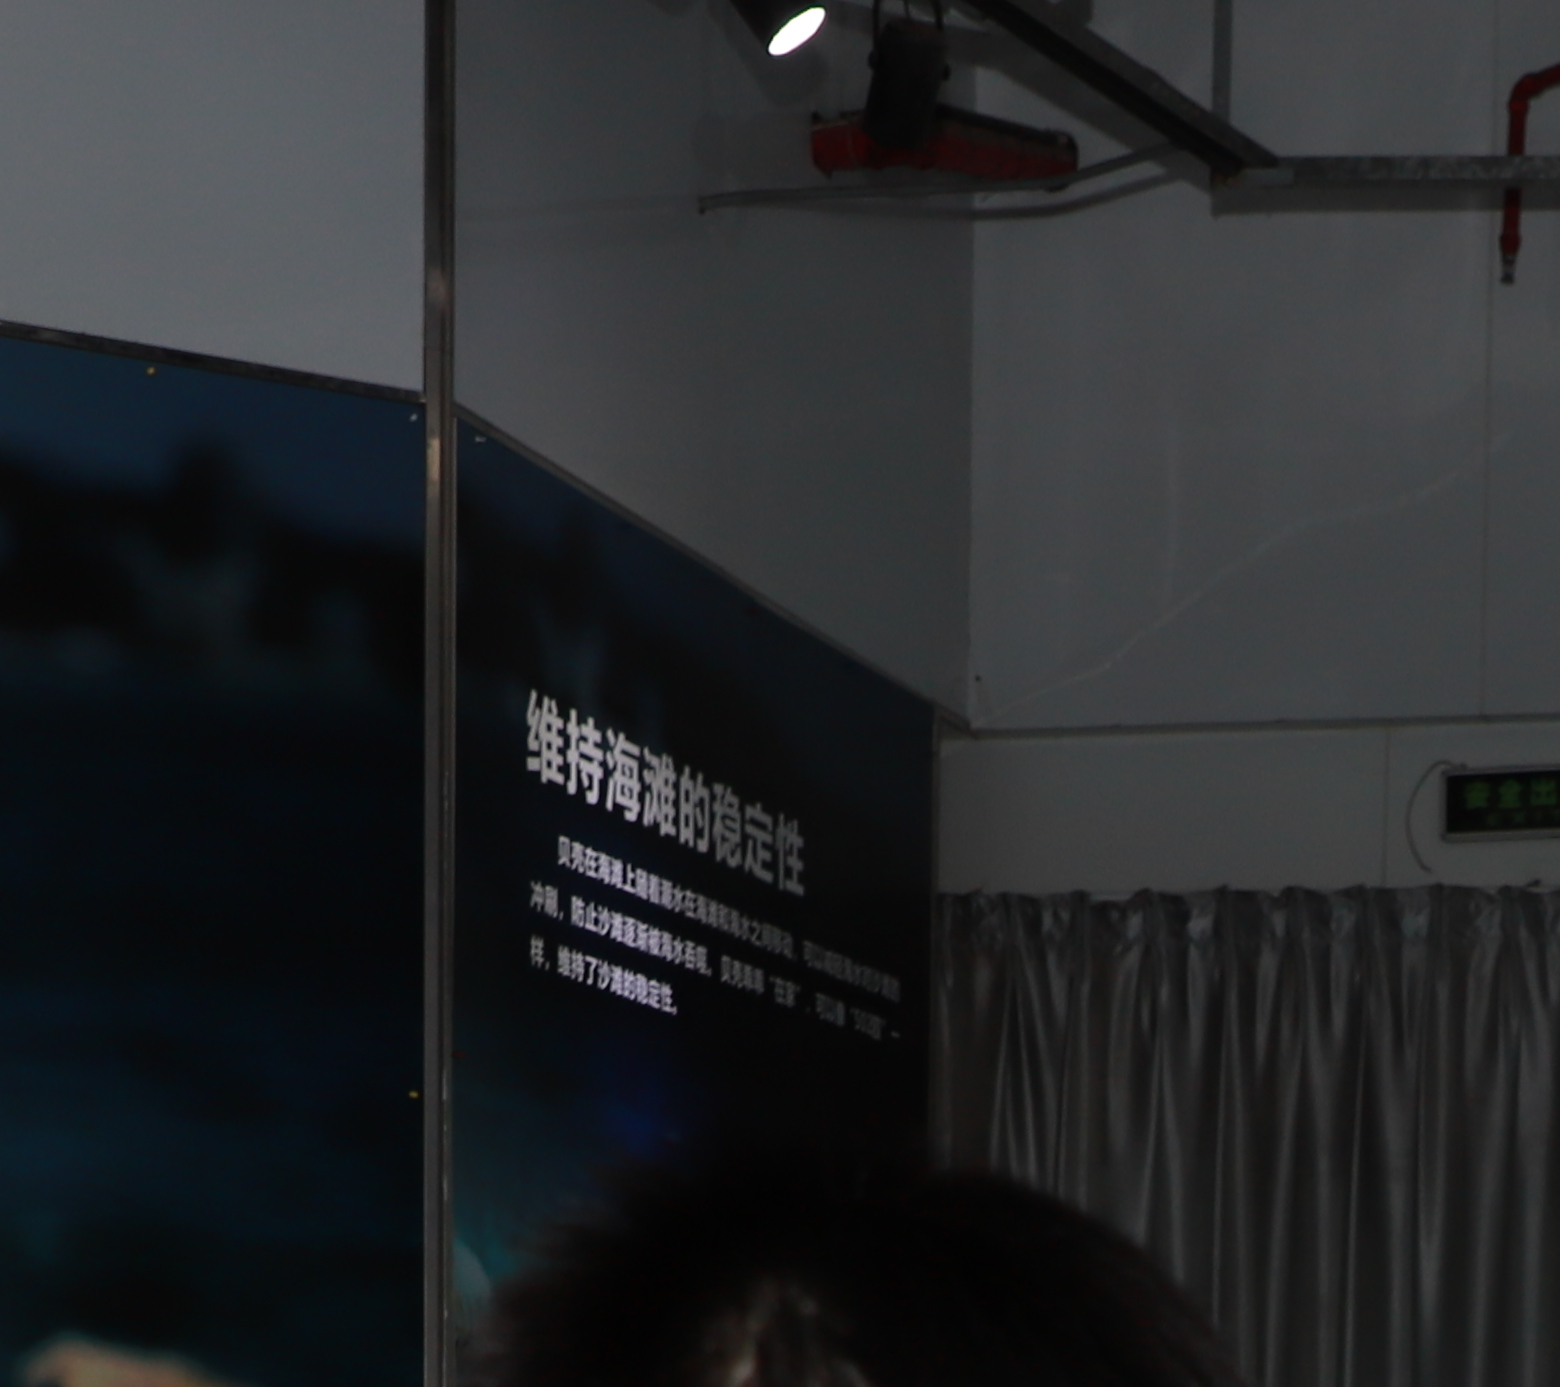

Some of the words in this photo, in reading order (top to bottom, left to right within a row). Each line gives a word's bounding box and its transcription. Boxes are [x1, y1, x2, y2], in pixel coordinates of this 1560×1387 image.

[525, 688, 805, 897] 维持海滩的稳定性
